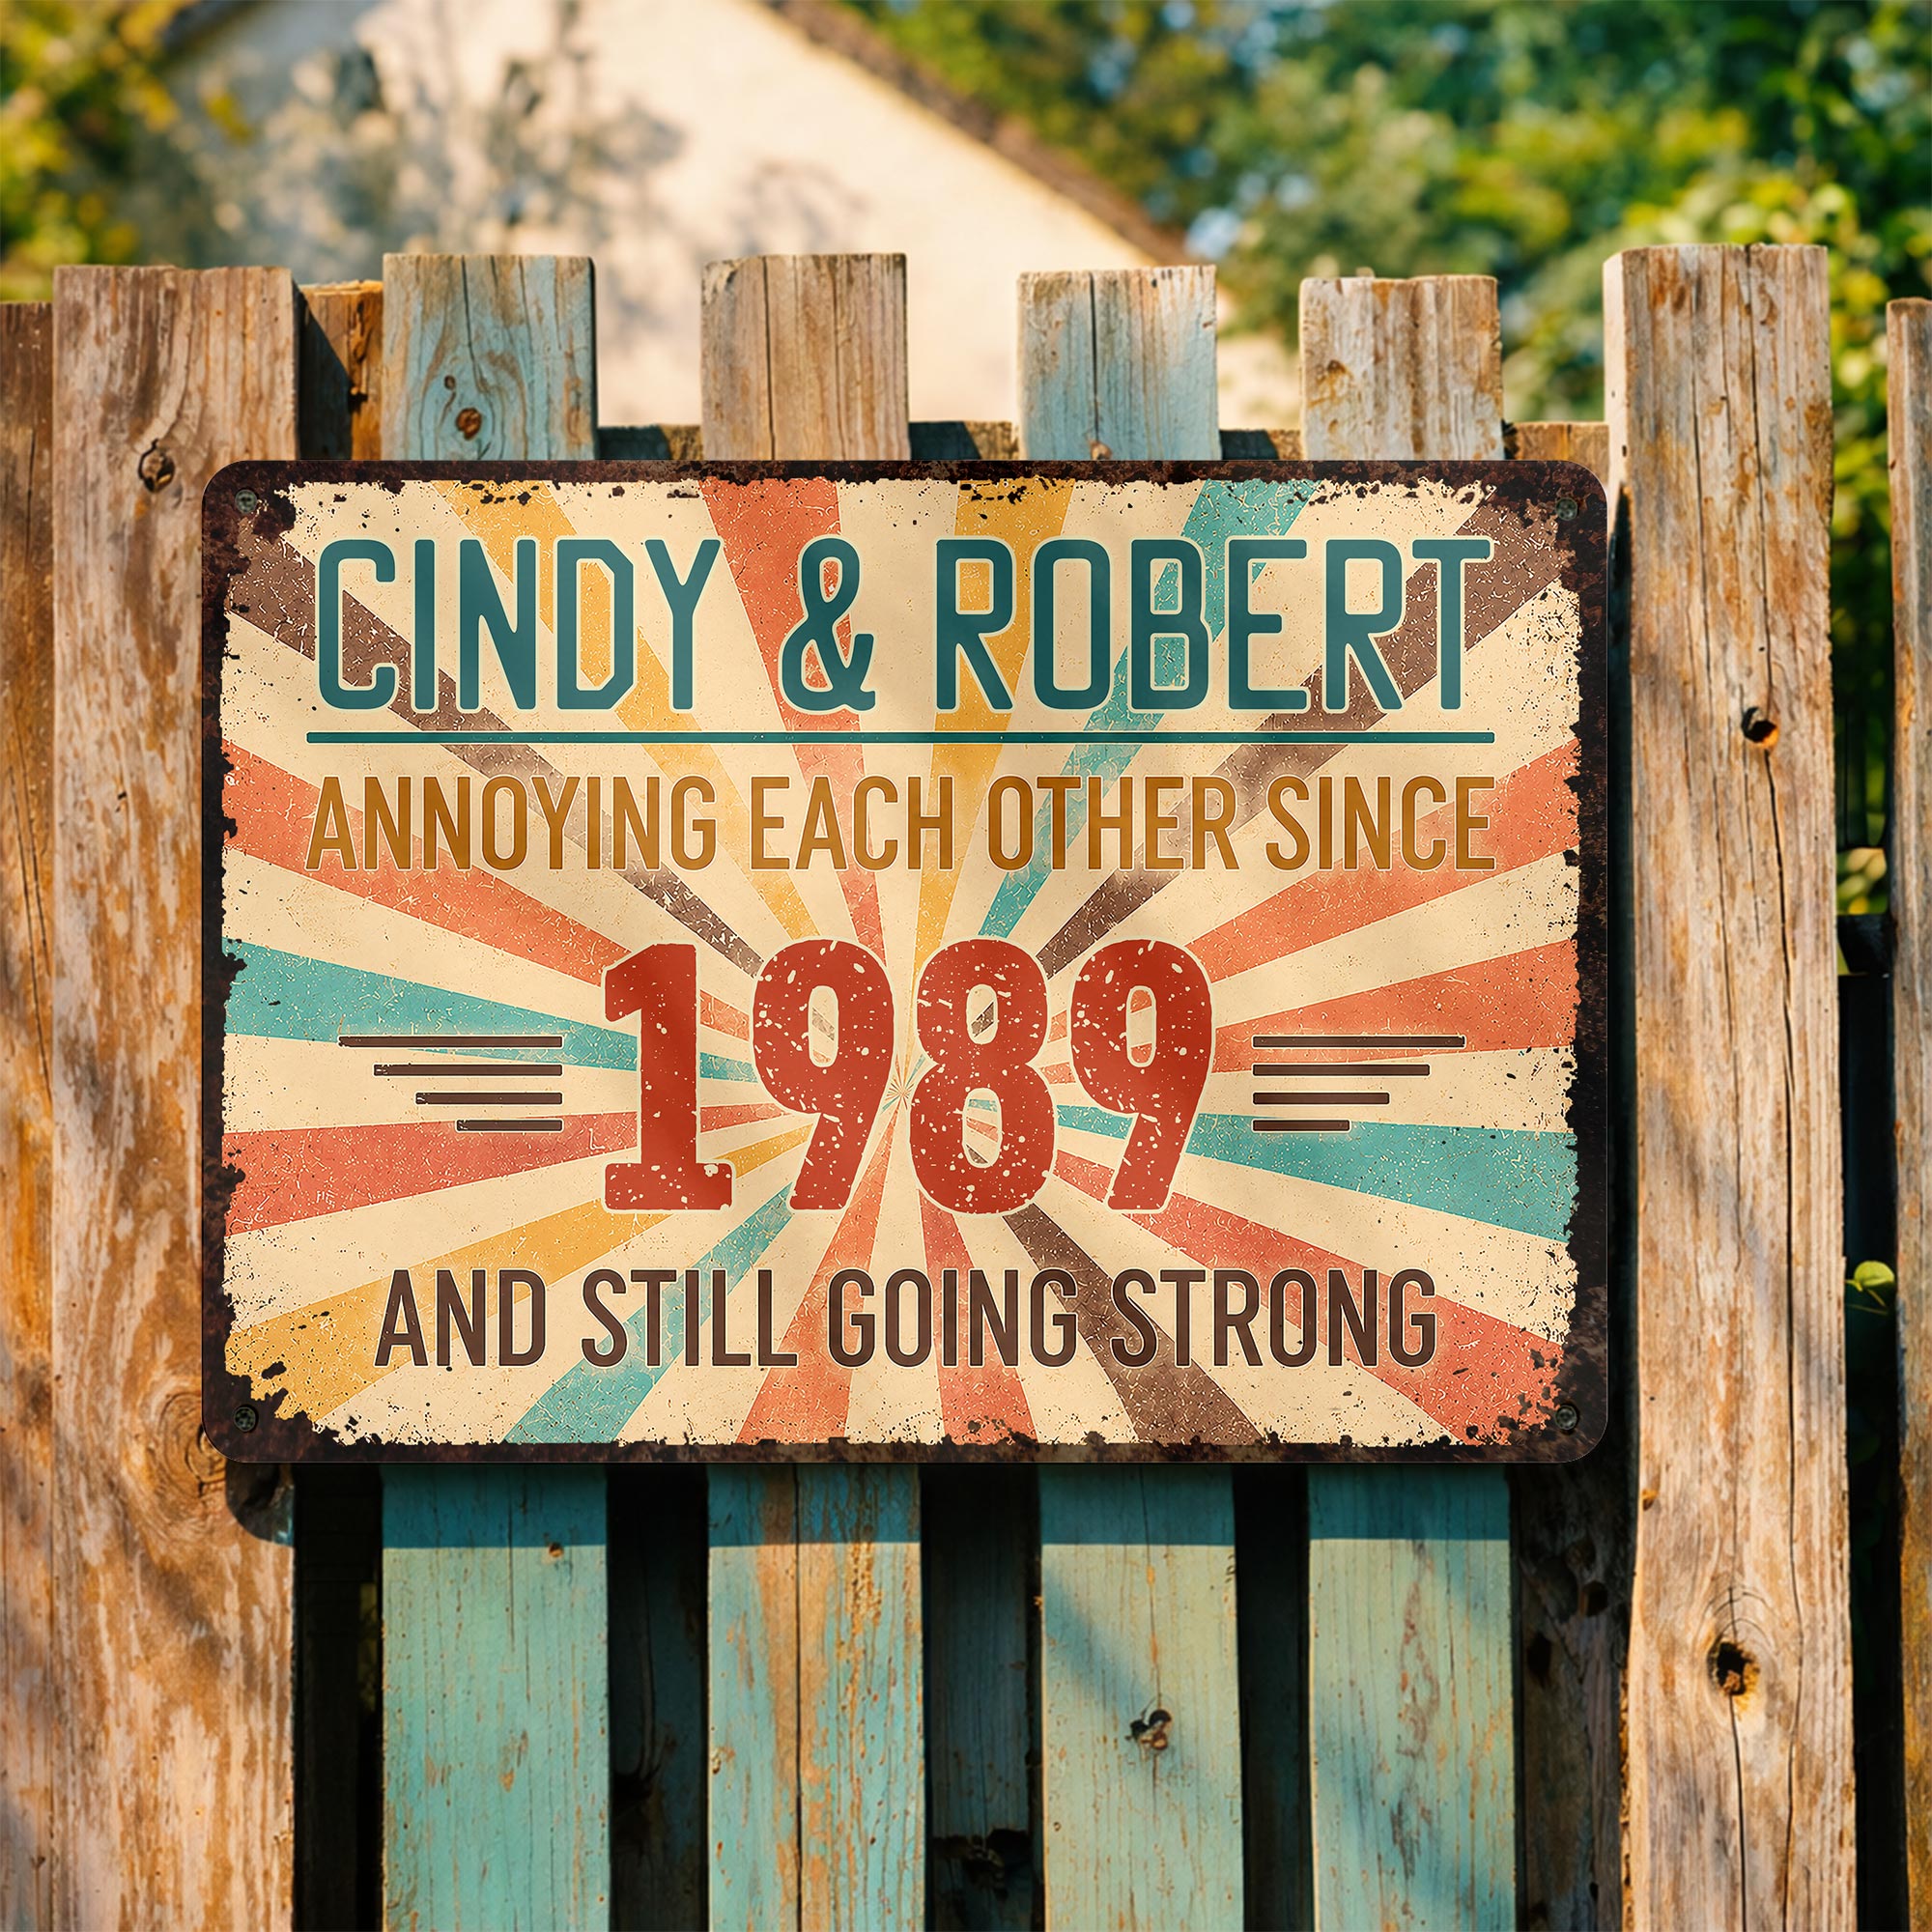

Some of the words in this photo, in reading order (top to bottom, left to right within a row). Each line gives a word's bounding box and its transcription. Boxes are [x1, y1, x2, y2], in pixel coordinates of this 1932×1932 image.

[318, 538, 722, 710] CINDY
[781, 537, 876, 711] &
[936, 538, 1492, 710] ROBERT
[305, 776, 716, 870] ANNOYING
[752, 776, 953, 870] EACH
[988, 776, 1239, 870] OTHER
[1266, 776, 1496, 870] SINCE
[604, 939, 1214, 1213] 1989
[376, 1269, 546, 1367] AND
[582, 1269, 798, 1367] STILL
[828, 1269, 1079, 1367] GOING
[1111, 1269, 1437, 1367] STRONG
